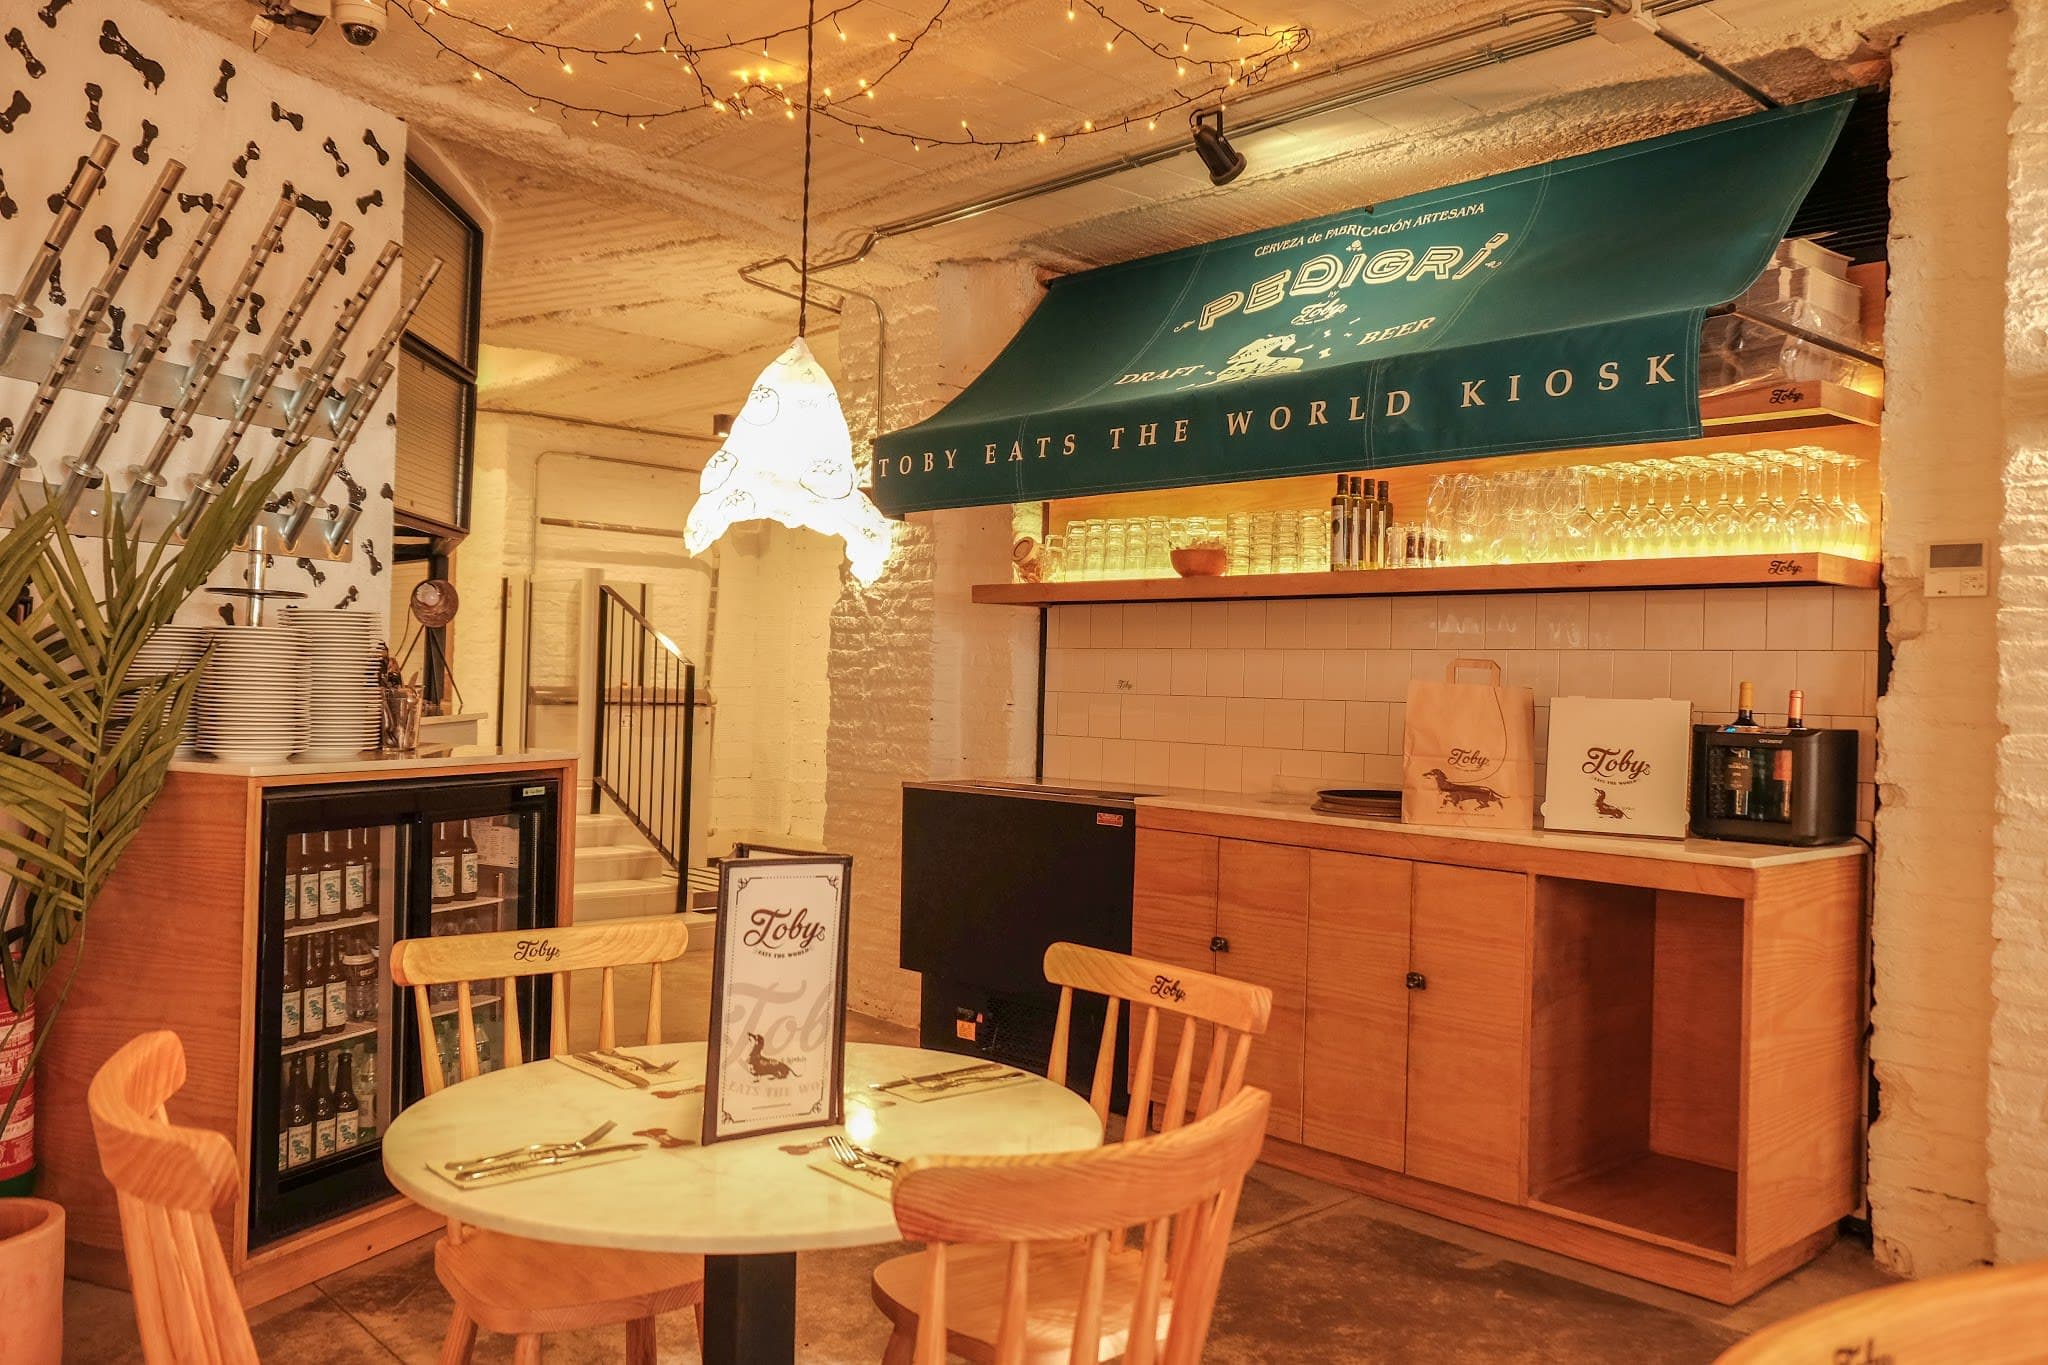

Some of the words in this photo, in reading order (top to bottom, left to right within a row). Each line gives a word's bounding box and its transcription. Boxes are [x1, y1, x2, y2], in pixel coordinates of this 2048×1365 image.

[1254, 237, 1305, 257] CERVEZA
[1307, 232, 1322, 244] de
[1325, 219, 1411, 240] FABRICACIÓN
[1412, 203, 1485, 228] ARTESANA
[1114, 365, 1205, 385] DRAFT
[1356, 316, 1437, 346] BEER
[878, 449, 957, 478] TOBY
[985, 434, 1076, 465] EATS
[1109, 419, 1189, 450] THE
[1226, 389, 1411, 437] WORLD
[1460, 353, 1676, 408] KIOSK
[1448, 748, 1488, 769] Toby
[1582, 747, 1649, 780] Toby
[743, 908, 823, 949] Toby
[514, 940, 559, 962] Toby
[1151, 975, 1184, 1002] Toby
